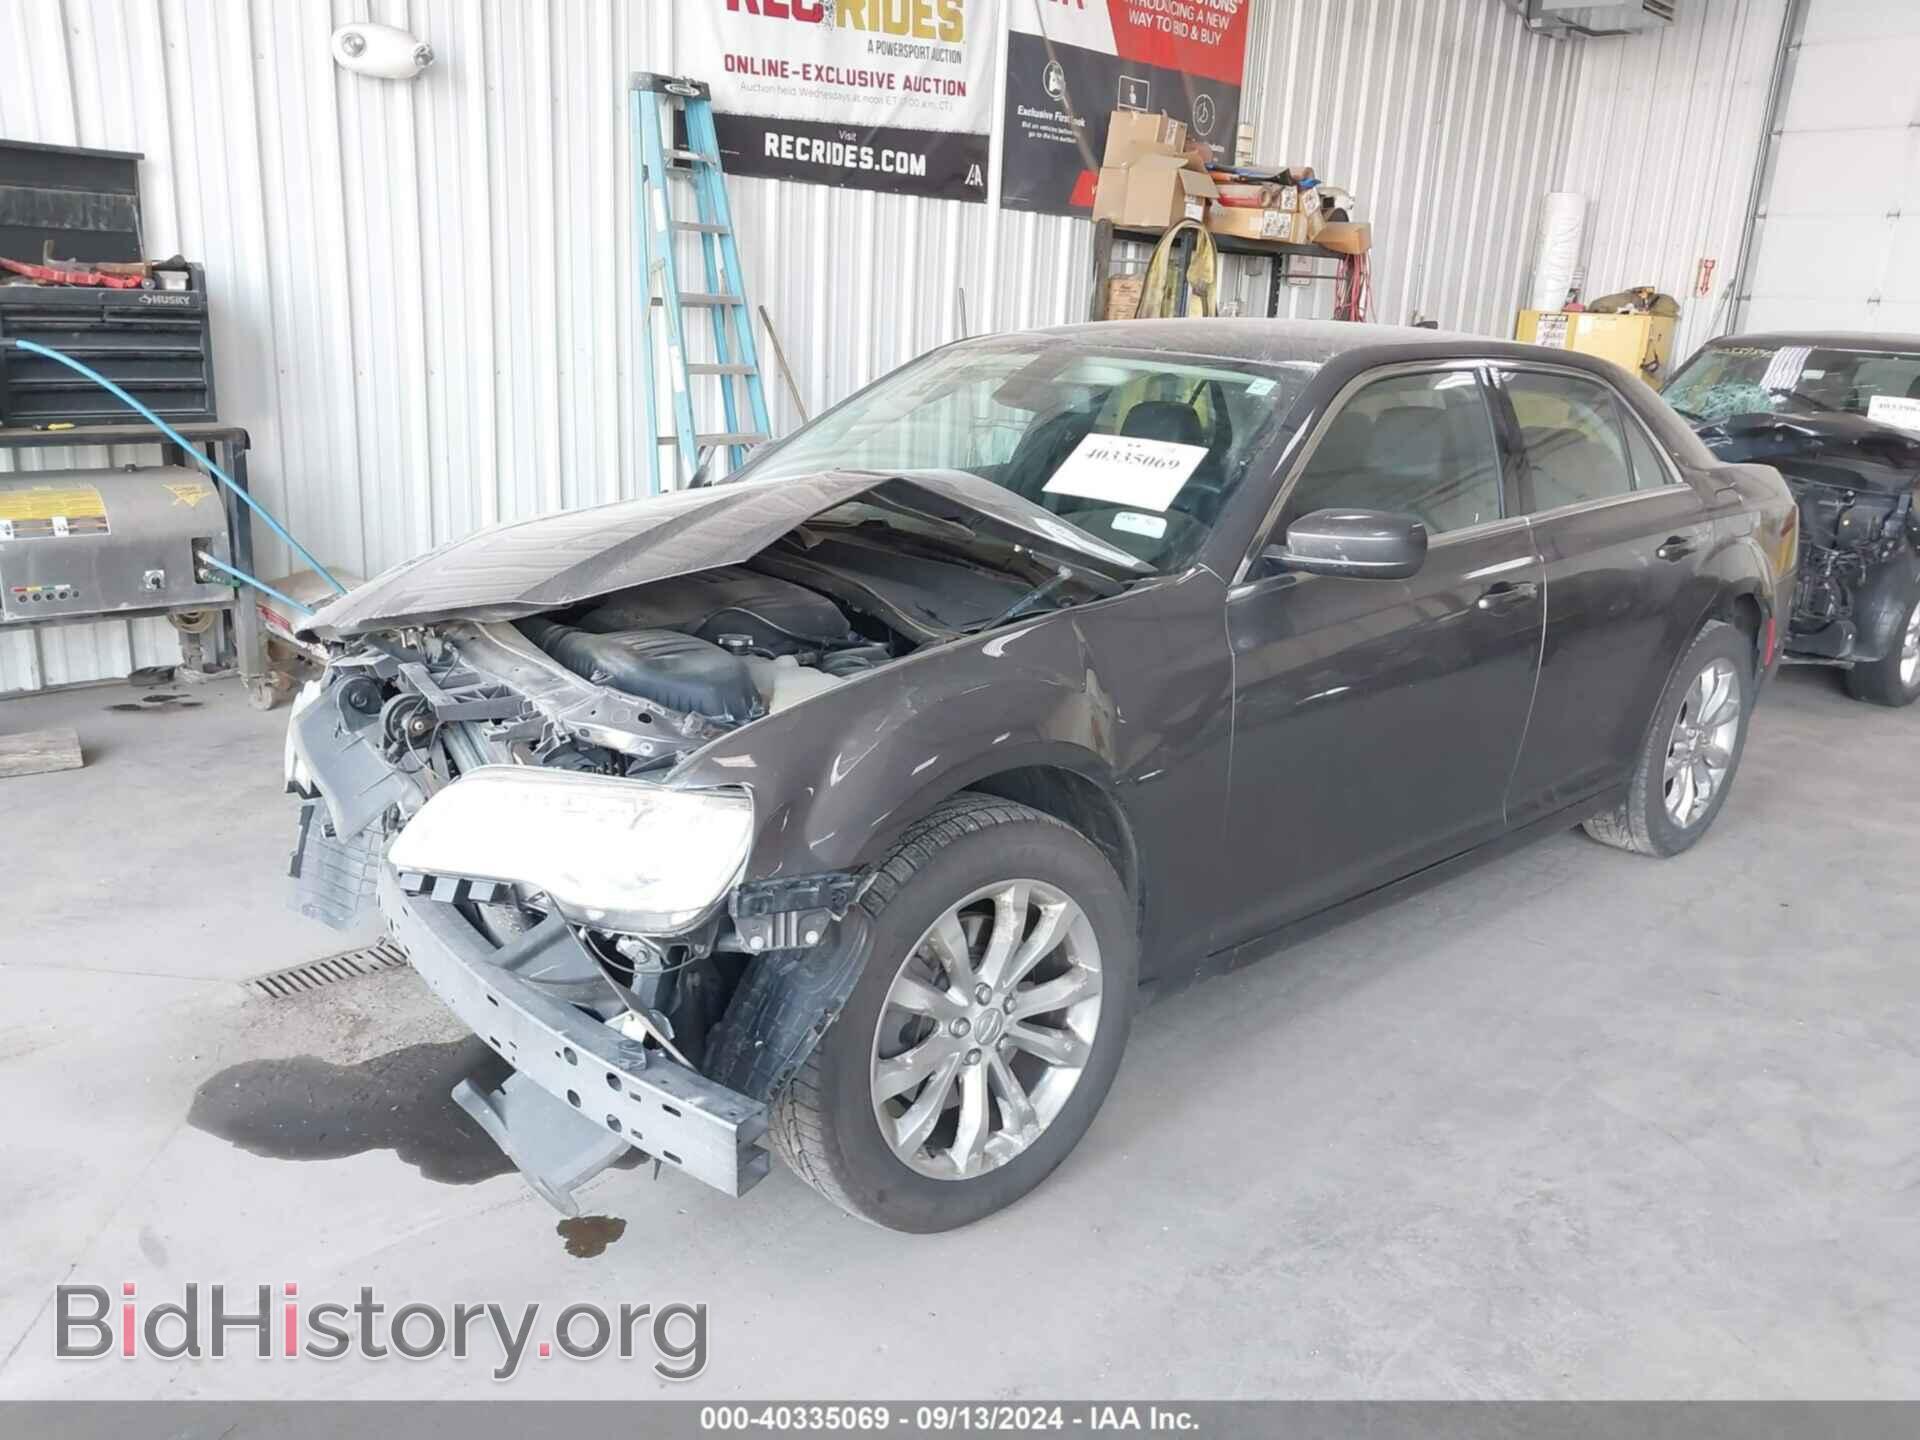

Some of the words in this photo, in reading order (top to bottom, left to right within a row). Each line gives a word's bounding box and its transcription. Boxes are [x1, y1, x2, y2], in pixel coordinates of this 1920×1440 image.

[1129, 8, 1153, 28] WAY
[1155, 15, 1171, 32] TO
[1173, 20, 1188, 37] BID
[1190, 25, 1198, 40] &
[1201, 28, 1222, 45] BUY
[1196, 9, 1204, 24] A
[1207, 11, 1230, 30] NEW
[867, 39, 874, 54] A
[876, 40, 930, 60] POWERSPORT
[931, 46, 962, 64] AUCTION
[724, 54, 895, 89] ONLINE-EXCLUSIVE
[903, 75, 966, 96] AUCTION
[741, 81, 775, 94] Auction
[1017, 105, 1053, 120] Exclusive
[838, 130, 857, 141] Visit
[764, 131, 927, 177] RECRIDES.COM
[152, 295, 190, 305] HUSKY
